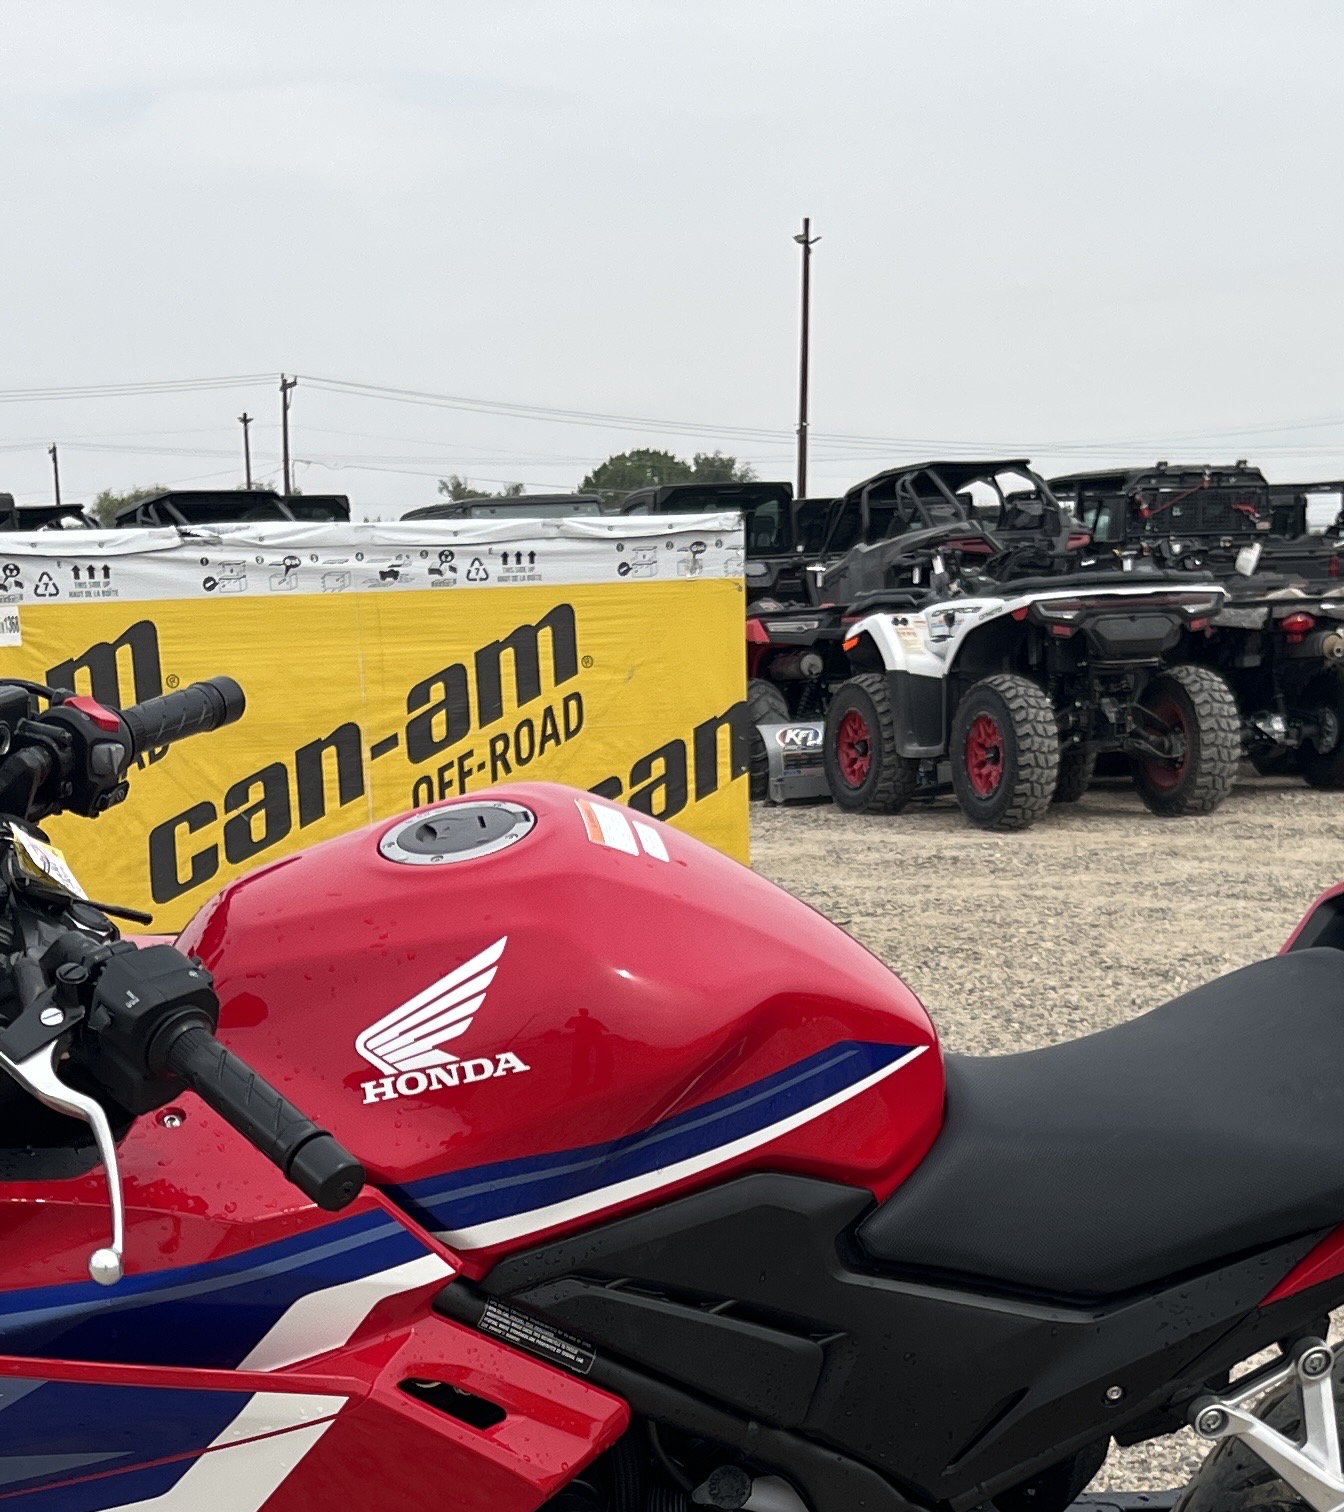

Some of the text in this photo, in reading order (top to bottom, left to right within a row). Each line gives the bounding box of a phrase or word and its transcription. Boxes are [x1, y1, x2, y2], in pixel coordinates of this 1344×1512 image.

[149, 603, 578, 905] can-am
[412, 691, 584, 809] OFF-ROAD
[587, 700, 750, 822] an
[360, 1051, 531, 1105] HONDA
